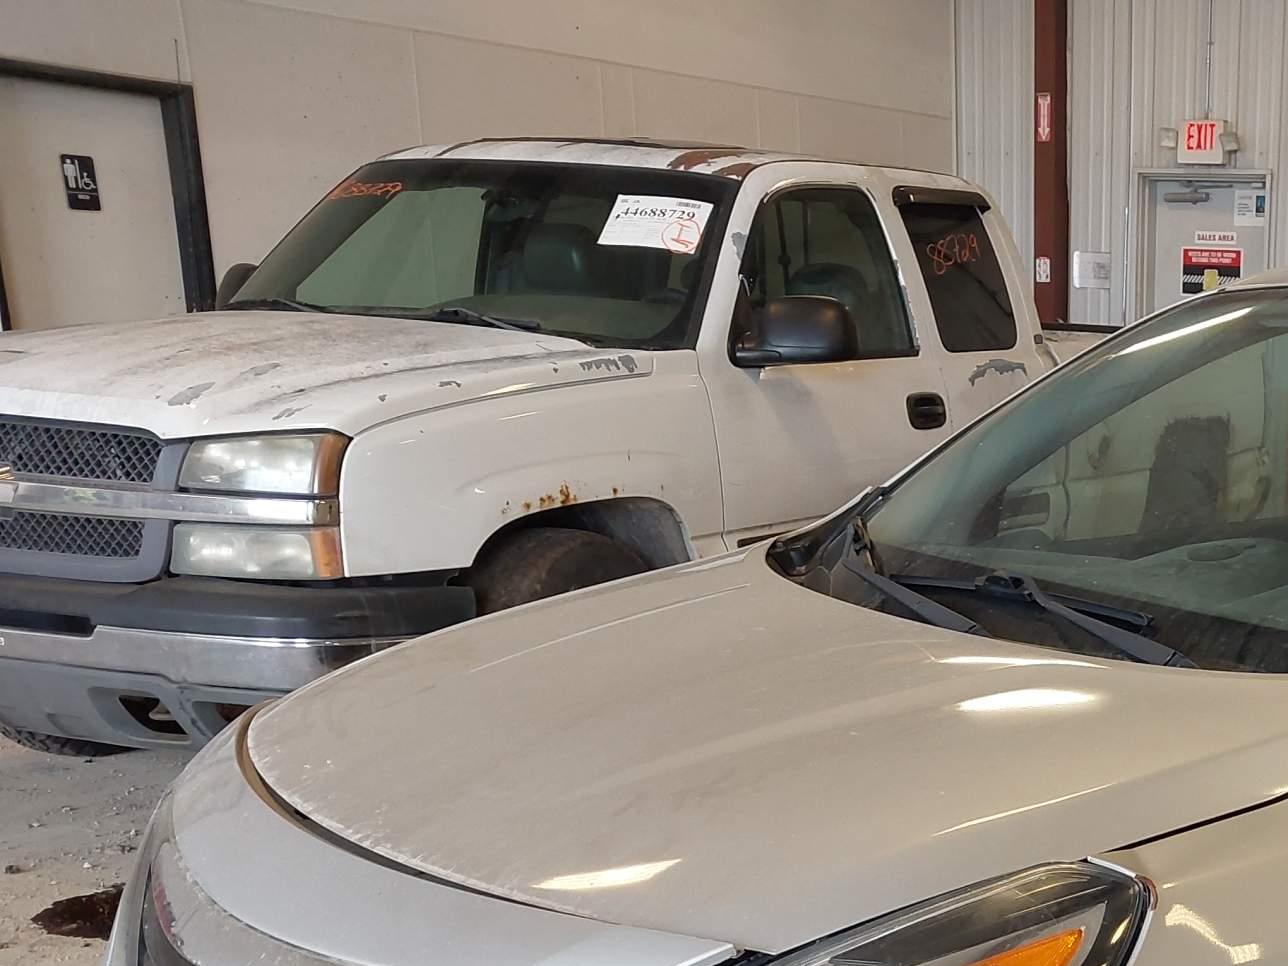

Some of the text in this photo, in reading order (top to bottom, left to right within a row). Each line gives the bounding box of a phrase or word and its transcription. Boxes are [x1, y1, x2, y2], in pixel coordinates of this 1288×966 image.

[1186, 123, 1216, 150] EXIT
[620, 206, 696, 220] 44688729
[1218, 233, 1235, 241] AREA
